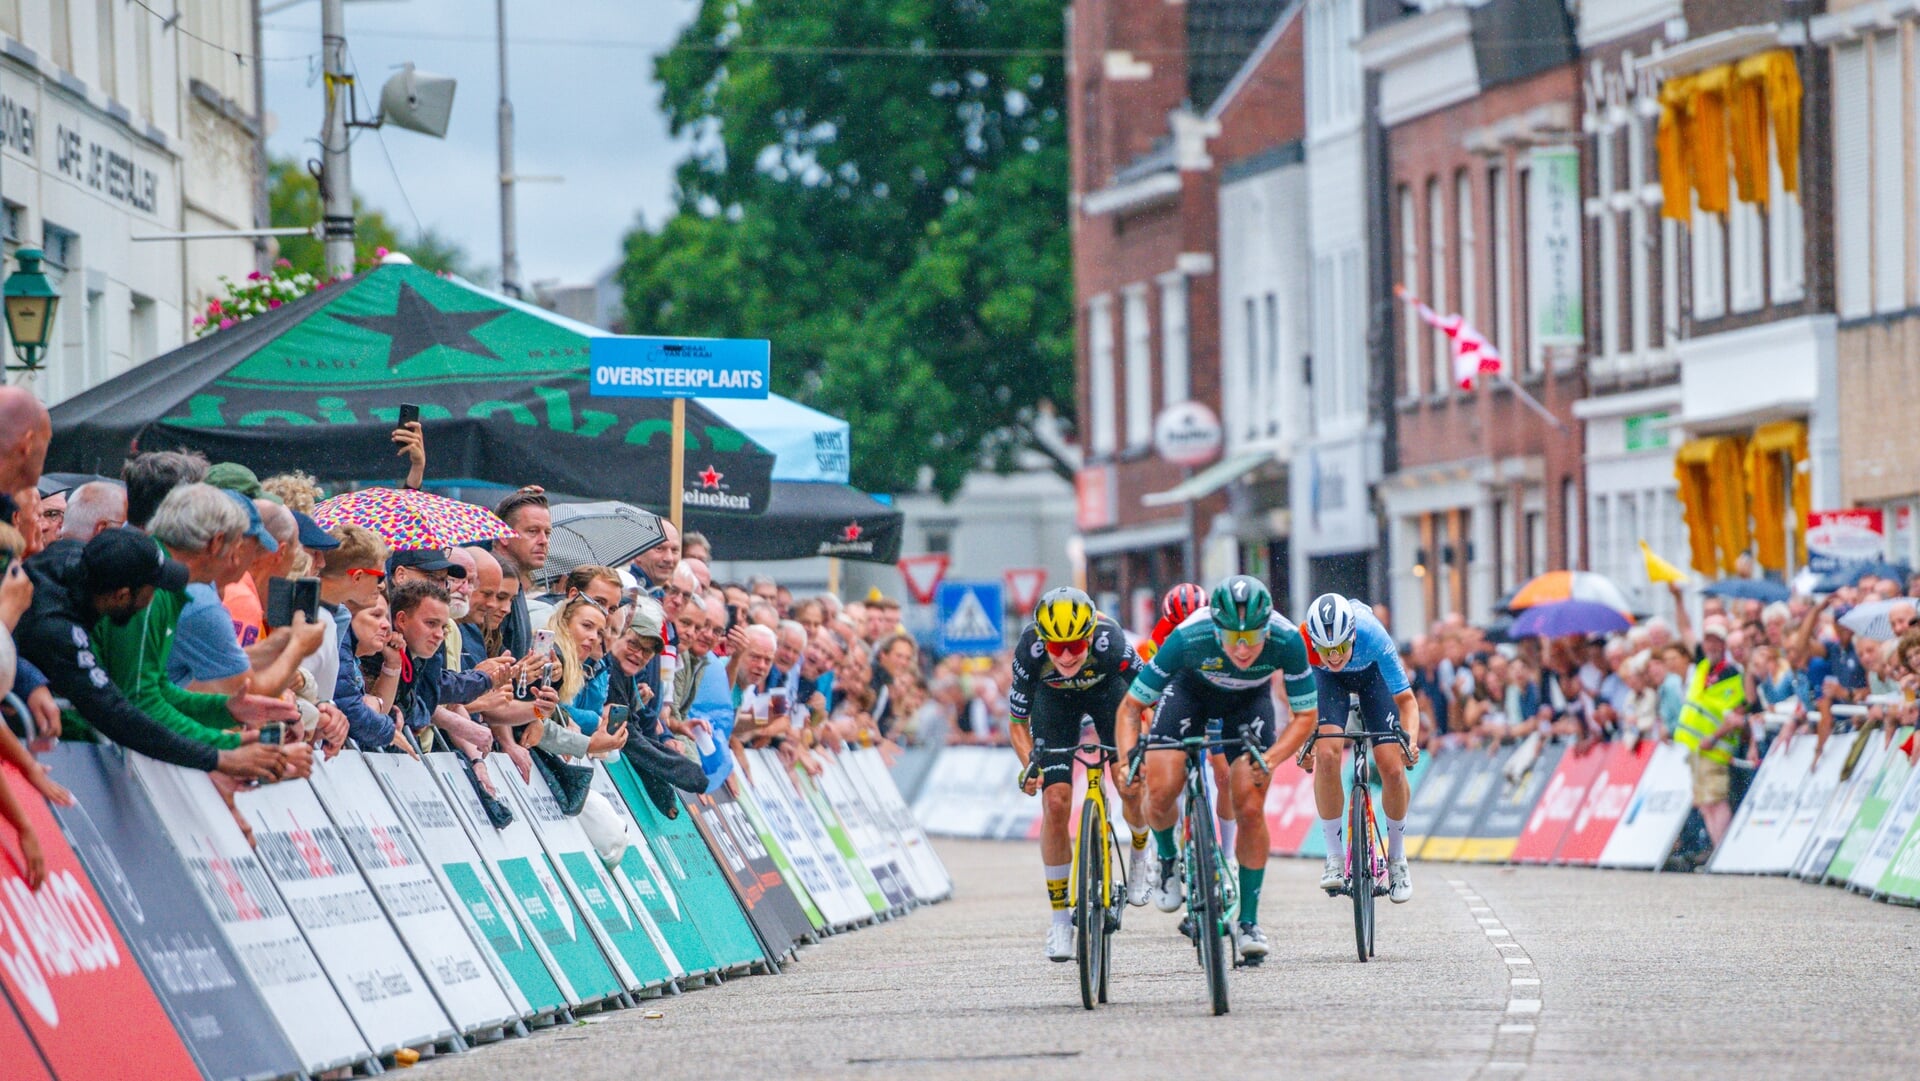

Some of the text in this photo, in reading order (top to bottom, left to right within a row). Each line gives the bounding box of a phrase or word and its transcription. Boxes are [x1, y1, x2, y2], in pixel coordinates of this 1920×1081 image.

[596, 366, 763, 389] OVERSTEEKPLAATS
[683, 488, 750, 510] eineken
[254, 807, 357, 882] keukensale.com
